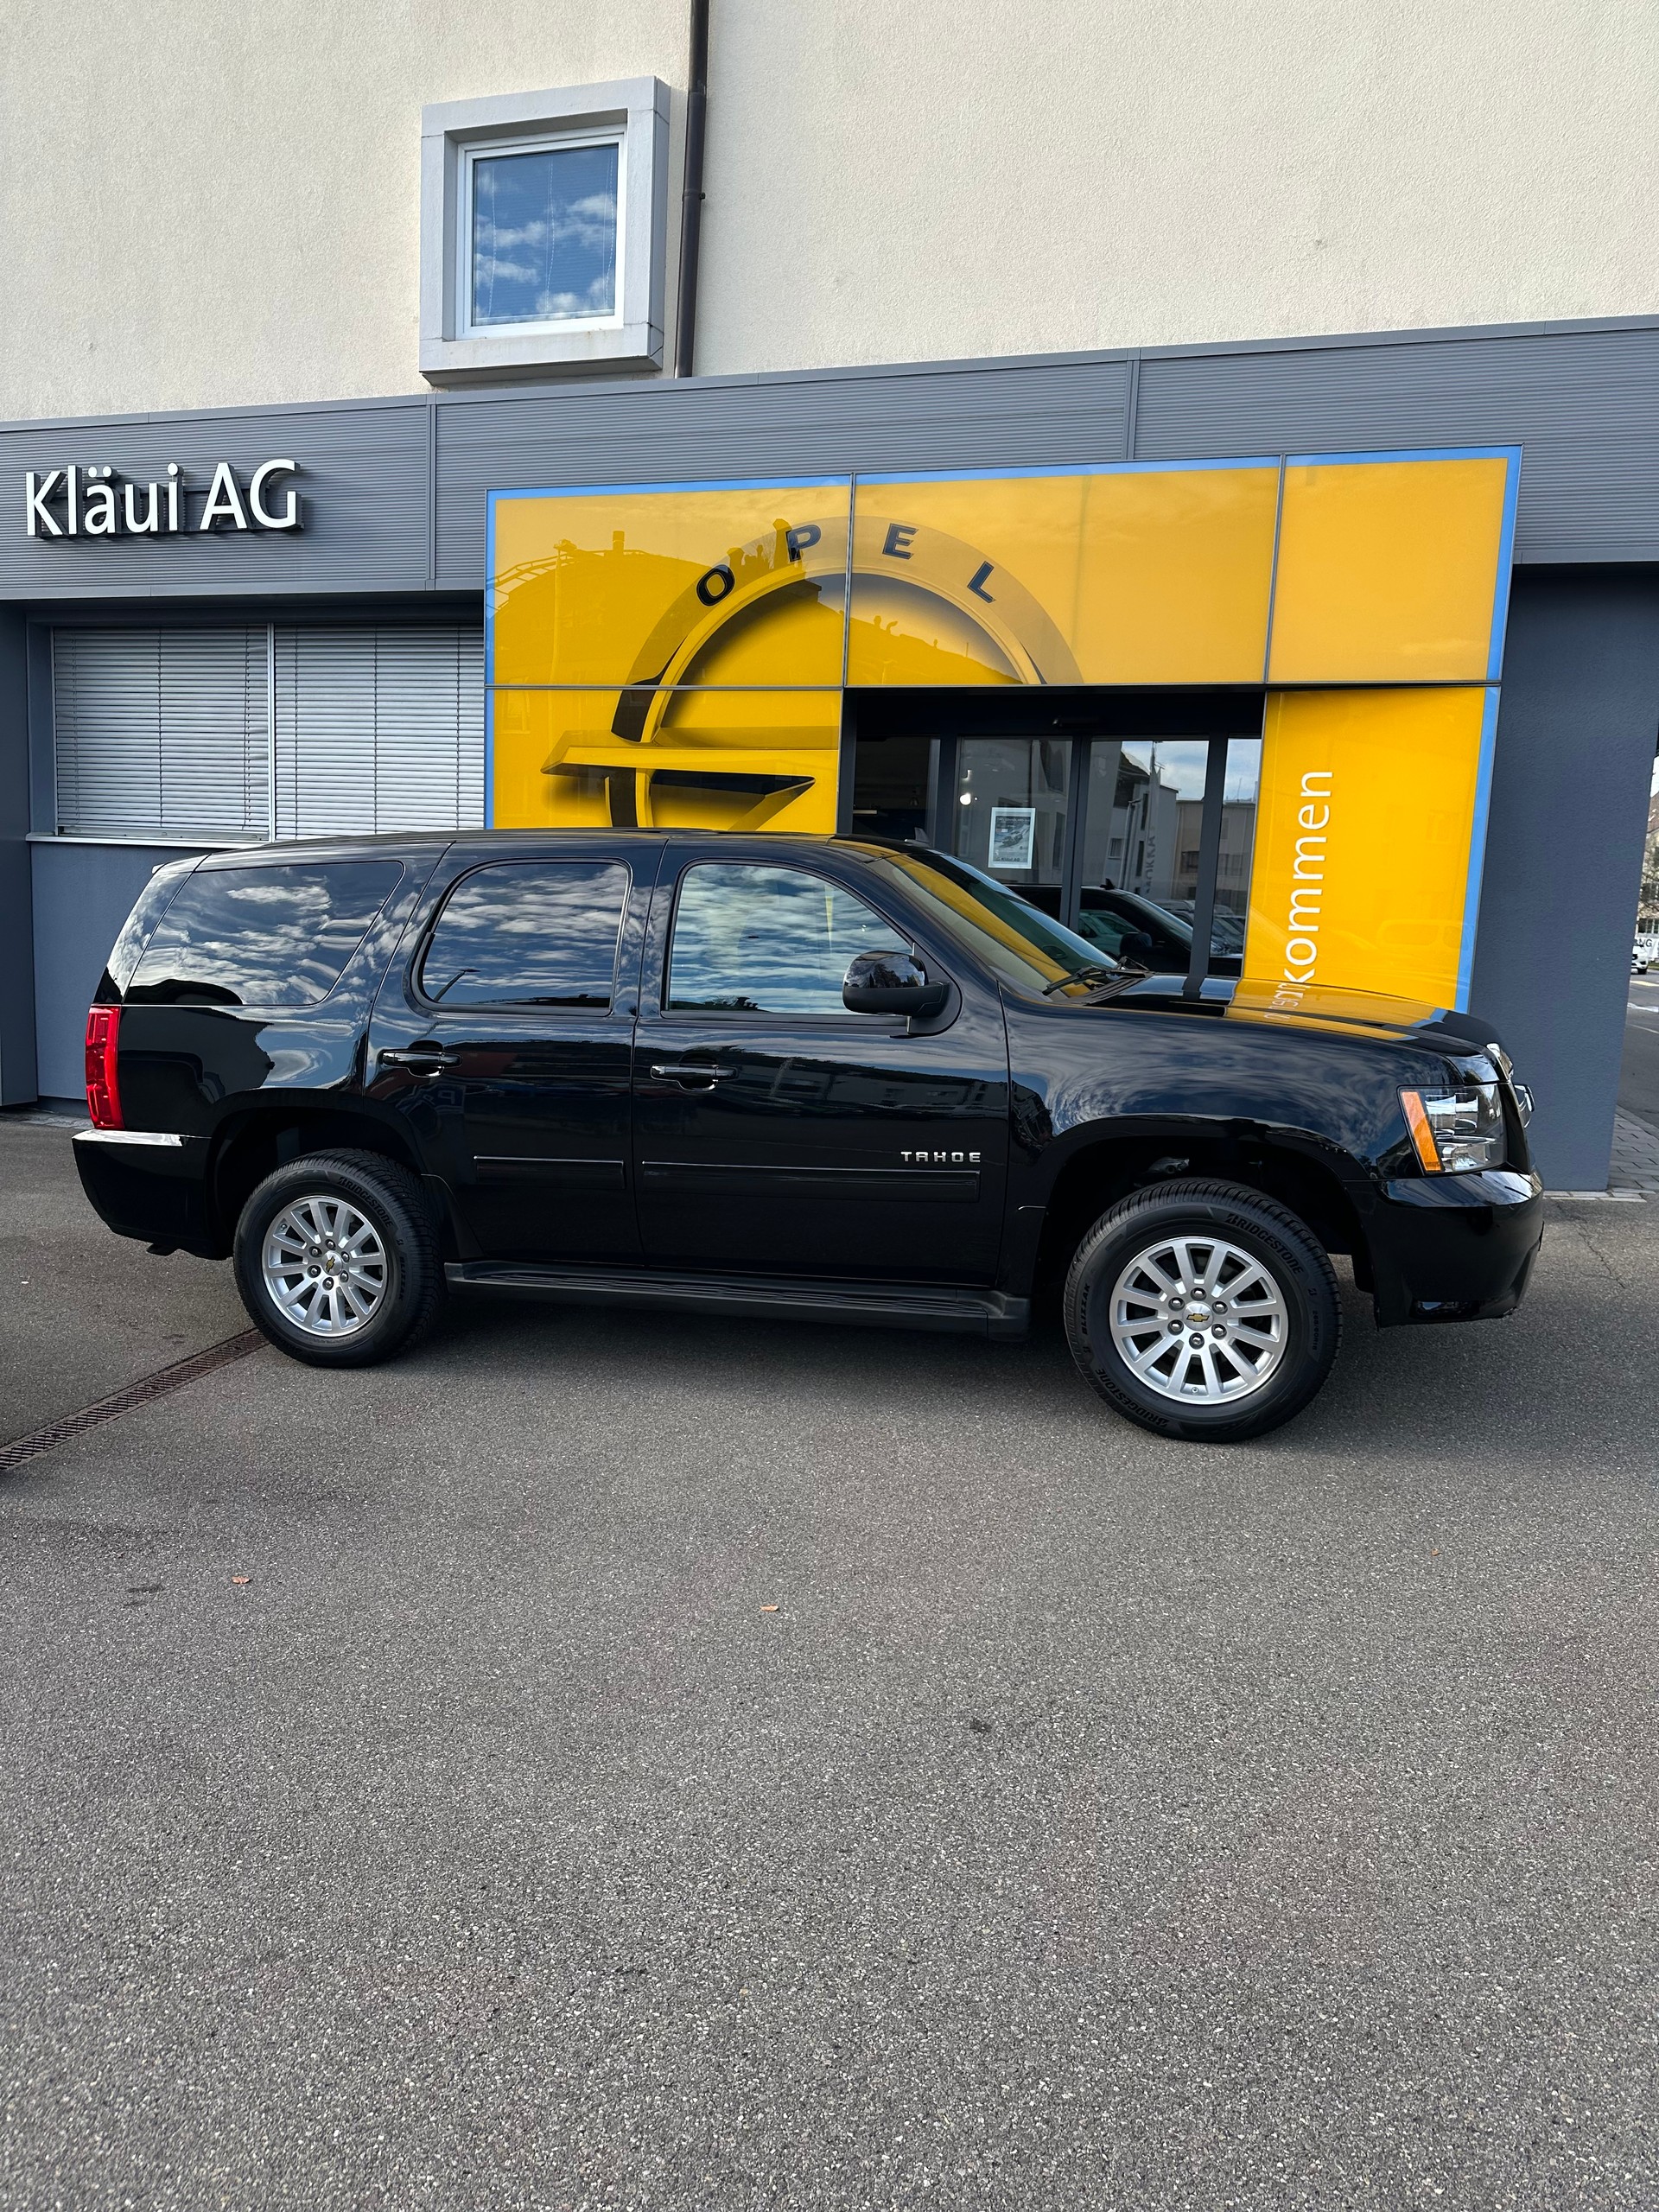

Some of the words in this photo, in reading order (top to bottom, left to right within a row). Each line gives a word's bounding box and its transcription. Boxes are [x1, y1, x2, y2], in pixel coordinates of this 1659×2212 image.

[26, 462, 179, 537] Kläui
[200, 458, 299, 531] AG
[696, 523, 995, 606] OPEL
[900, 1151, 981, 1162] TAHOE
[337, 1176, 394, 1228] BRIDGESTONE
[1224, 1213, 1305, 1275] BRIDGESTONE
[1080, 1282, 1090, 1335] BLIZZAK
[1095, 1368, 1171, 1428] BRIDGESTONE
